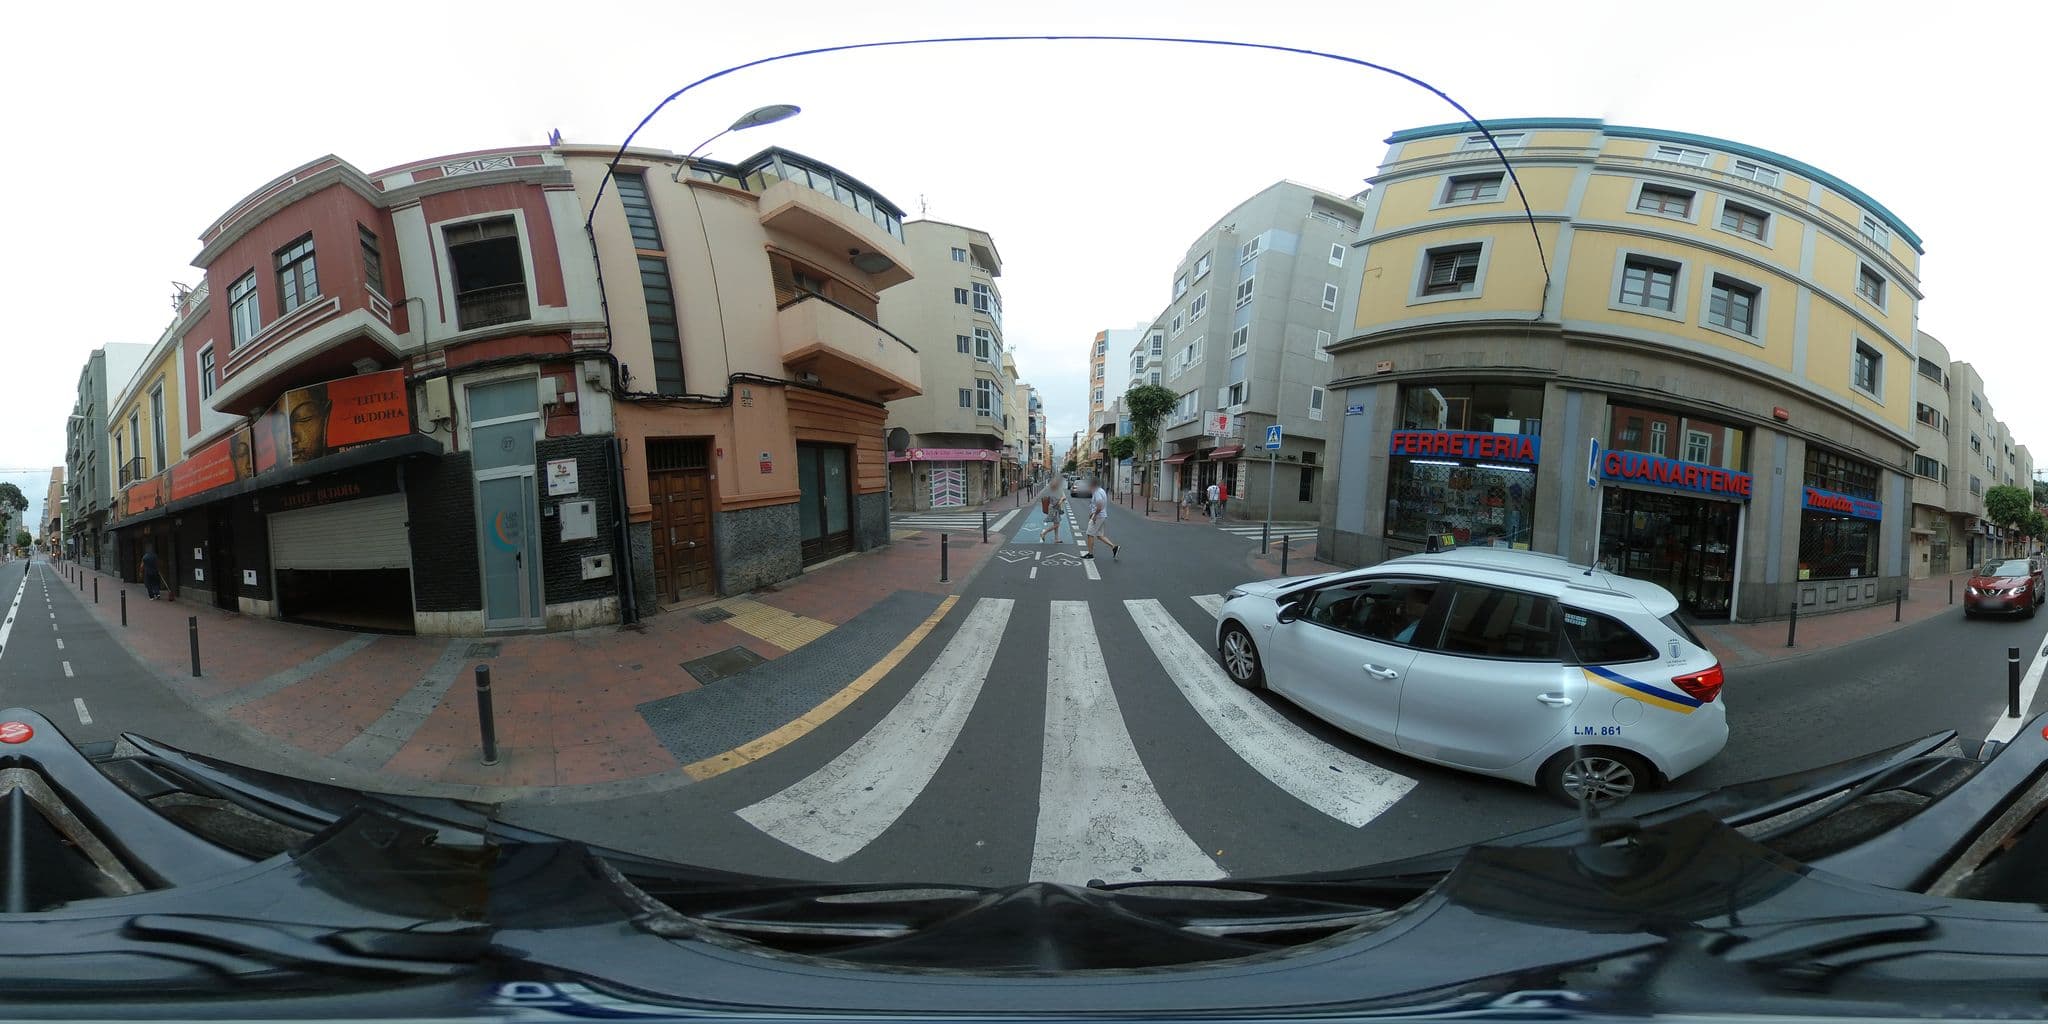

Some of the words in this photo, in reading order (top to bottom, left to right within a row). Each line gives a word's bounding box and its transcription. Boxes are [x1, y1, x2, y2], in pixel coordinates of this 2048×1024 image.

[354, 407, 404, 424] BUDDHA
[1393, 432, 1534, 460] FERRETERIA
[1605, 453, 1752, 495] GUANARTEME
[1574, 725, 1597, 736] L.M.
[1601, 725, 1621, 736] 861
